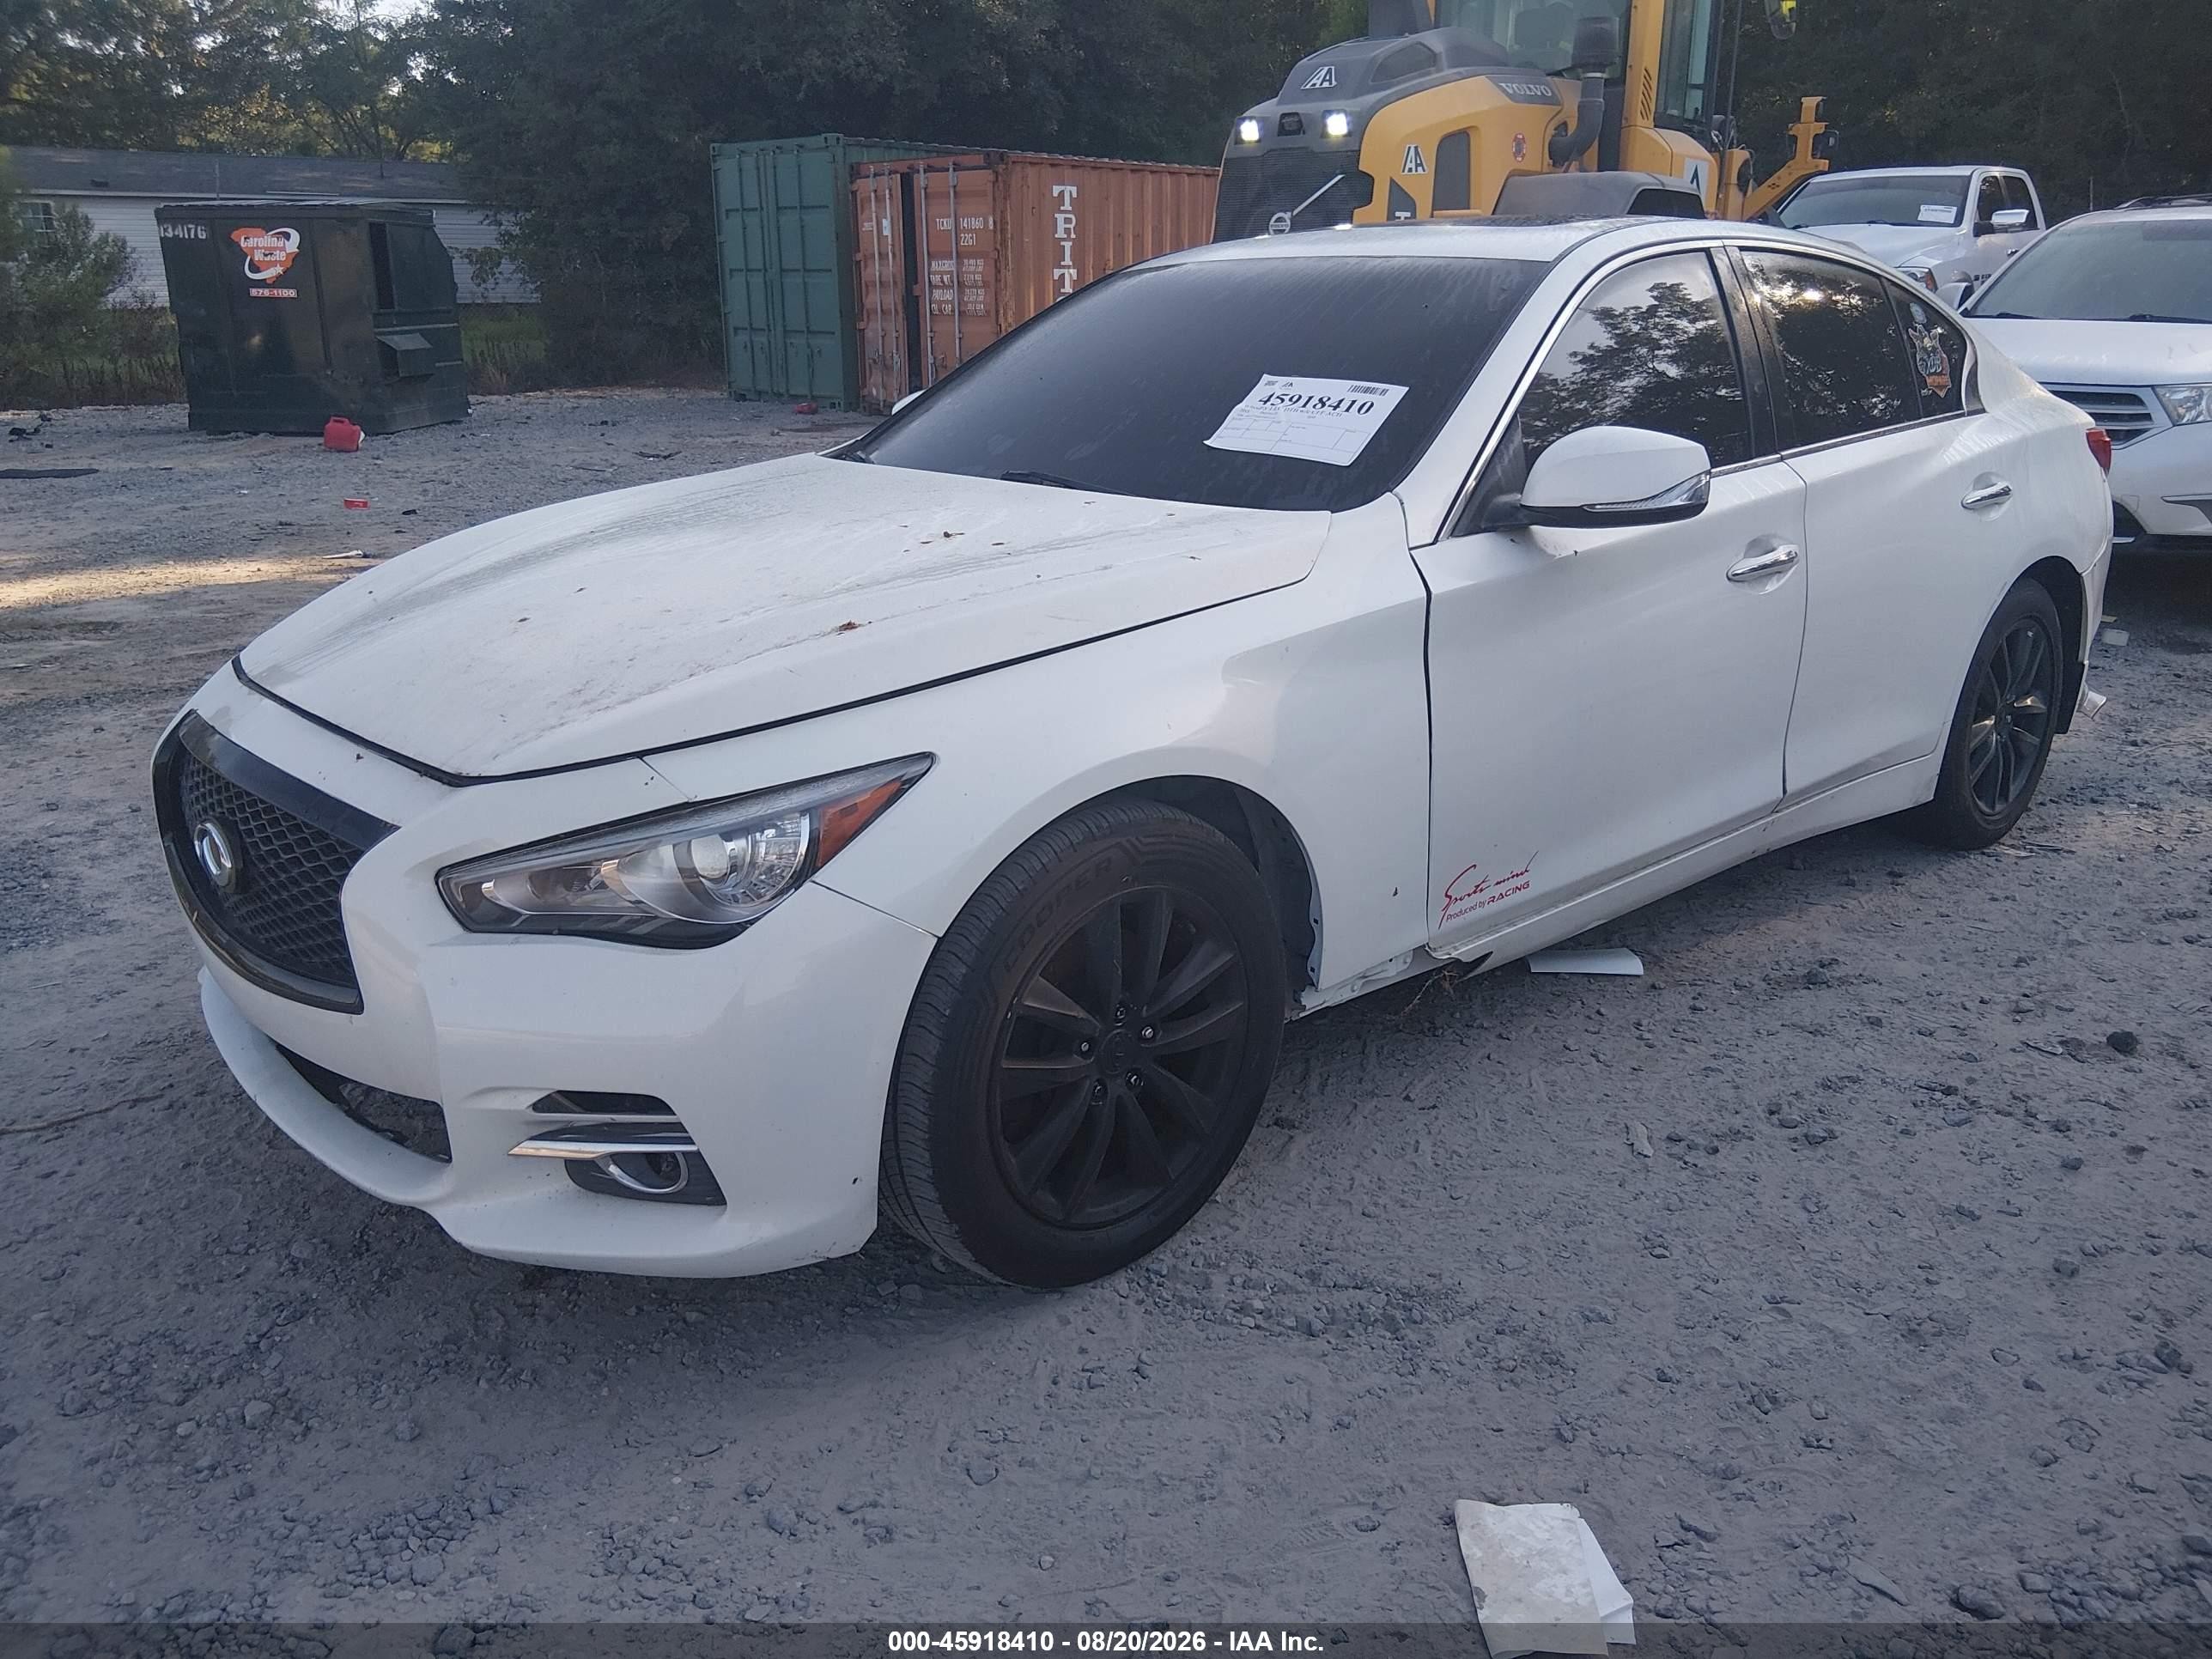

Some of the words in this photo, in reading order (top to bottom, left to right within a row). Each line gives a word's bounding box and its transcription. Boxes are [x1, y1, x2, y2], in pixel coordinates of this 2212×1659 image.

[1499, 82, 1553, 97] VOLVO
[959, 217, 984, 230] 141860
[988, 216, 994, 230] 8
[240, 234, 284, 248] Carolina
[1052, 185, 1078, 301] TRIT
[254, 249, 287, 261] Waste
[1258, 392, 1375, 416] 45918410
[1445, 901, 1478, 923] Produced
[1478, 899, 1487, 908] by
[1486, 879, 1531, 906] RACING
